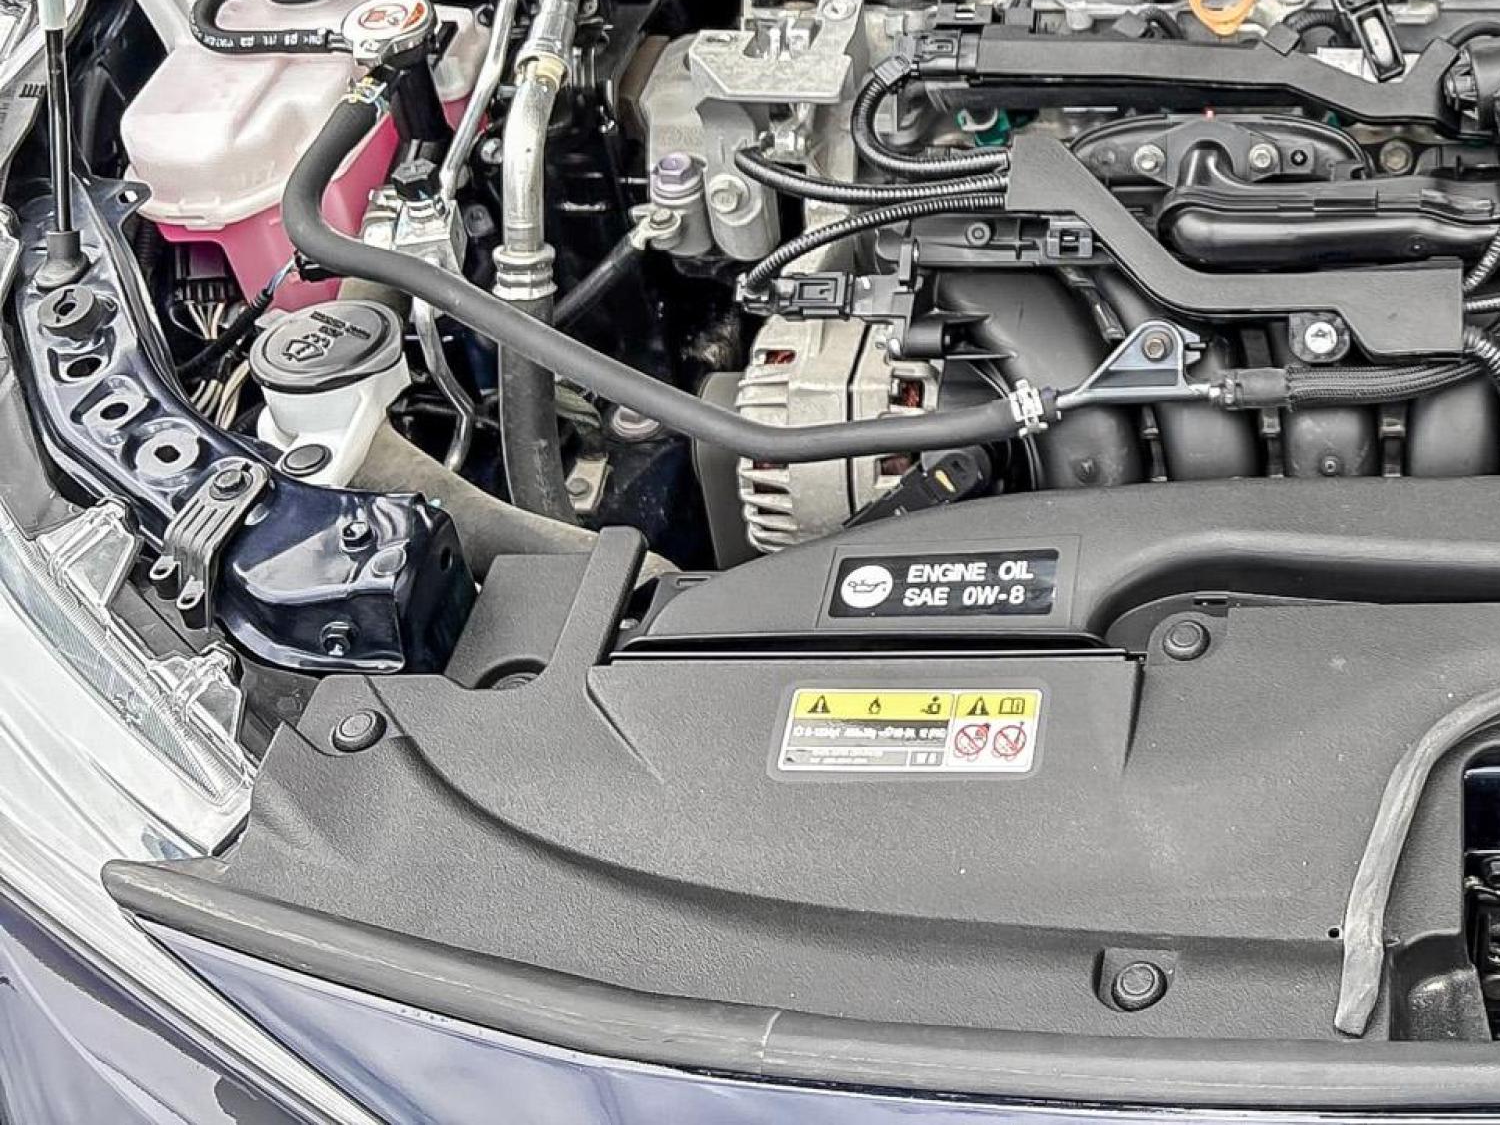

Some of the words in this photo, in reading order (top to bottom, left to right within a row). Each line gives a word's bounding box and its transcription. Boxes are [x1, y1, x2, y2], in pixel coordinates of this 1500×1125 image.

[906, 561, 988, 584] ENGINE
[998, 560, 1034, 581] OIL
[902, 586, 951, 607] SAE
[962, 584, 1026, 606] 0W-8
